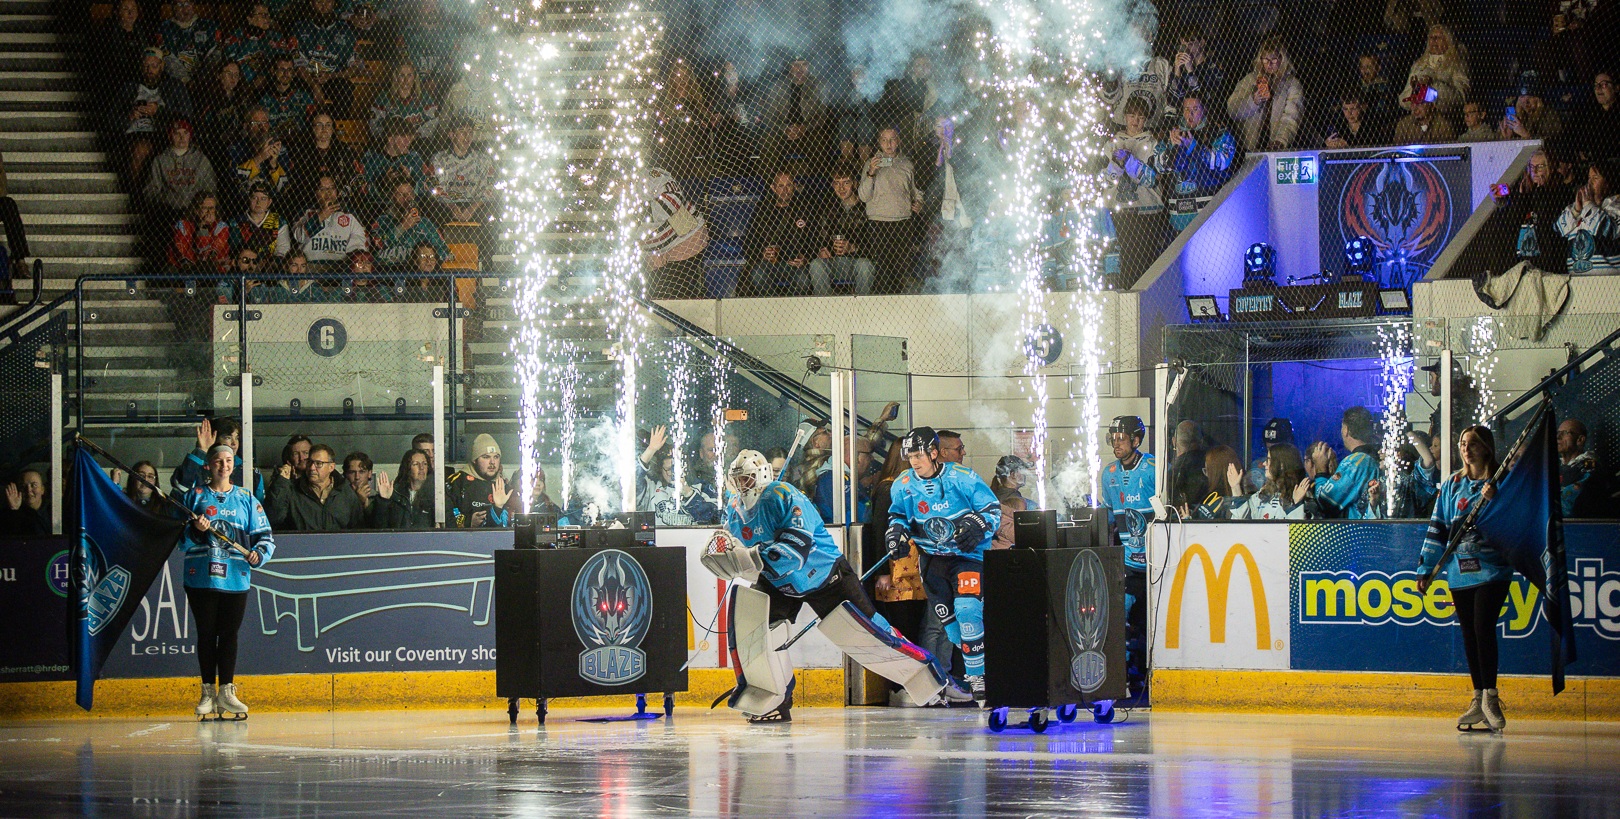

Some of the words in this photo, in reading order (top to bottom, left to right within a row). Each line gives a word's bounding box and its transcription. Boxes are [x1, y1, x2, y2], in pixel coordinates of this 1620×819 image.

[1277, 161, 1299, 171] Fire
[1277, 171, 1299, 180] exit
[311, 238, 348, 251] GIANTS
[1236, 295, 1274, 312] COVENTRY
[1338, 291, 1362, 308] BLAZE
[320, 325, 335, 350] 6
[1036, 332, 1049, 357] 5
[932, 500, 949, 512] dpd
[1126, 493, 1141, 504] dpd
[220, 508, 236, 517] dpd
[0, 567, 17, 582] u
[88, 570, 126, 630] BLAZE
[131, 560, 188, 642] SA
[1306, 578, 1540, 631] mosey
[131, 642, 196, 656] Leisu
[326, 647, 361, 663] Visit
[365, 650, 392, 662] our
[395, 646, 468, 664] Coventry
[471, 645, 497, 661] sho
[972, 642, 985, 652] dpd
[0, 664, 70, 674] sherratt@hrdep
[585, 648, 641, 679] BLAZE
[1073, 653, 1105, 686] BLAZE
